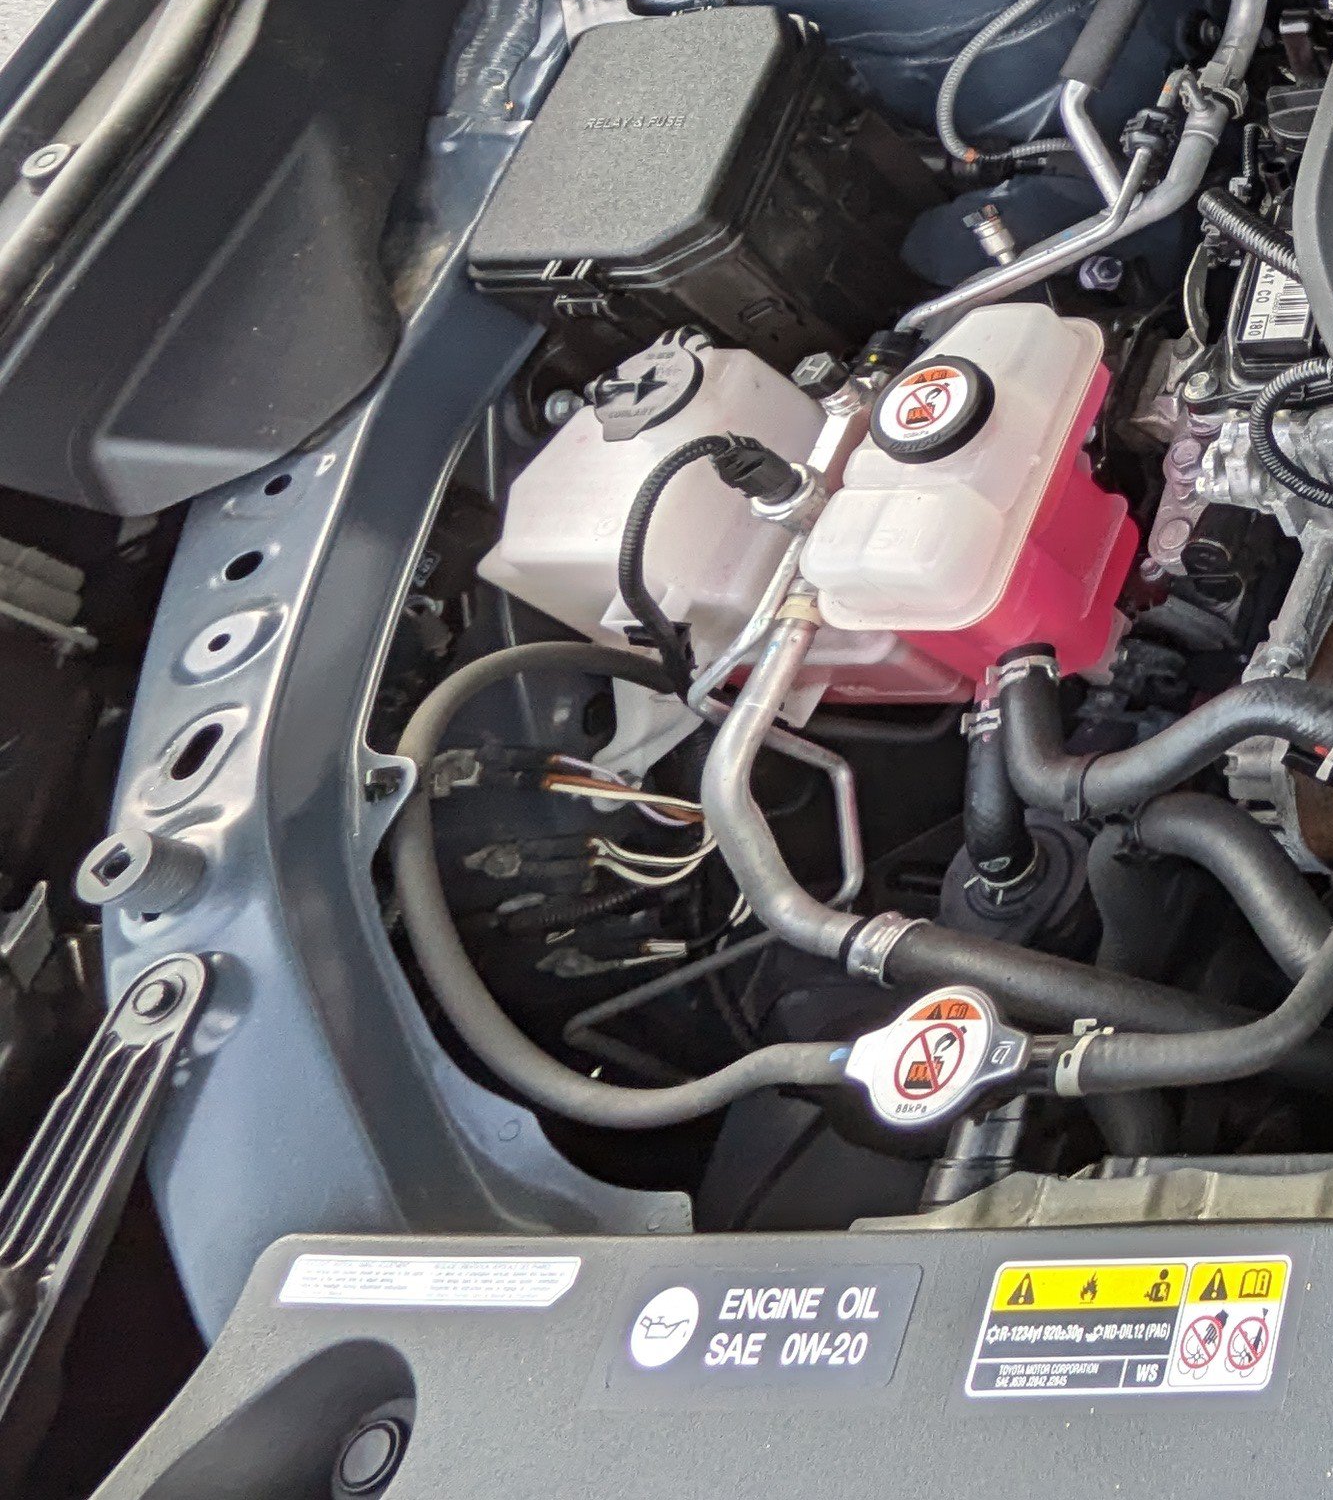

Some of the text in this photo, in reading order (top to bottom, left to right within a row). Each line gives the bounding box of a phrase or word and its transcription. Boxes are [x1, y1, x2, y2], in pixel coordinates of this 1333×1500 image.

[584, 116, 634, 130] RELAY
[647, 115, 686, 128] FUSE
[1248, 320, 1263, 336] 180
[895, 1103, 927, 1113] 88kPa
[718, 1286, 880, 1320] ENGINE OIL
[1133, 1324, 1145, 1339] 12
[1145, 1322, 1171, 1341] (PAG)
[704, 1332, 868, 1366] SAE 0W-20
[998, 1363, 1099, 1376] TOYOTA MOTOR CORPORATION
[1136, 1364, 1159, 1382] WS
[995, 1376, 1010, 1388] SAE
